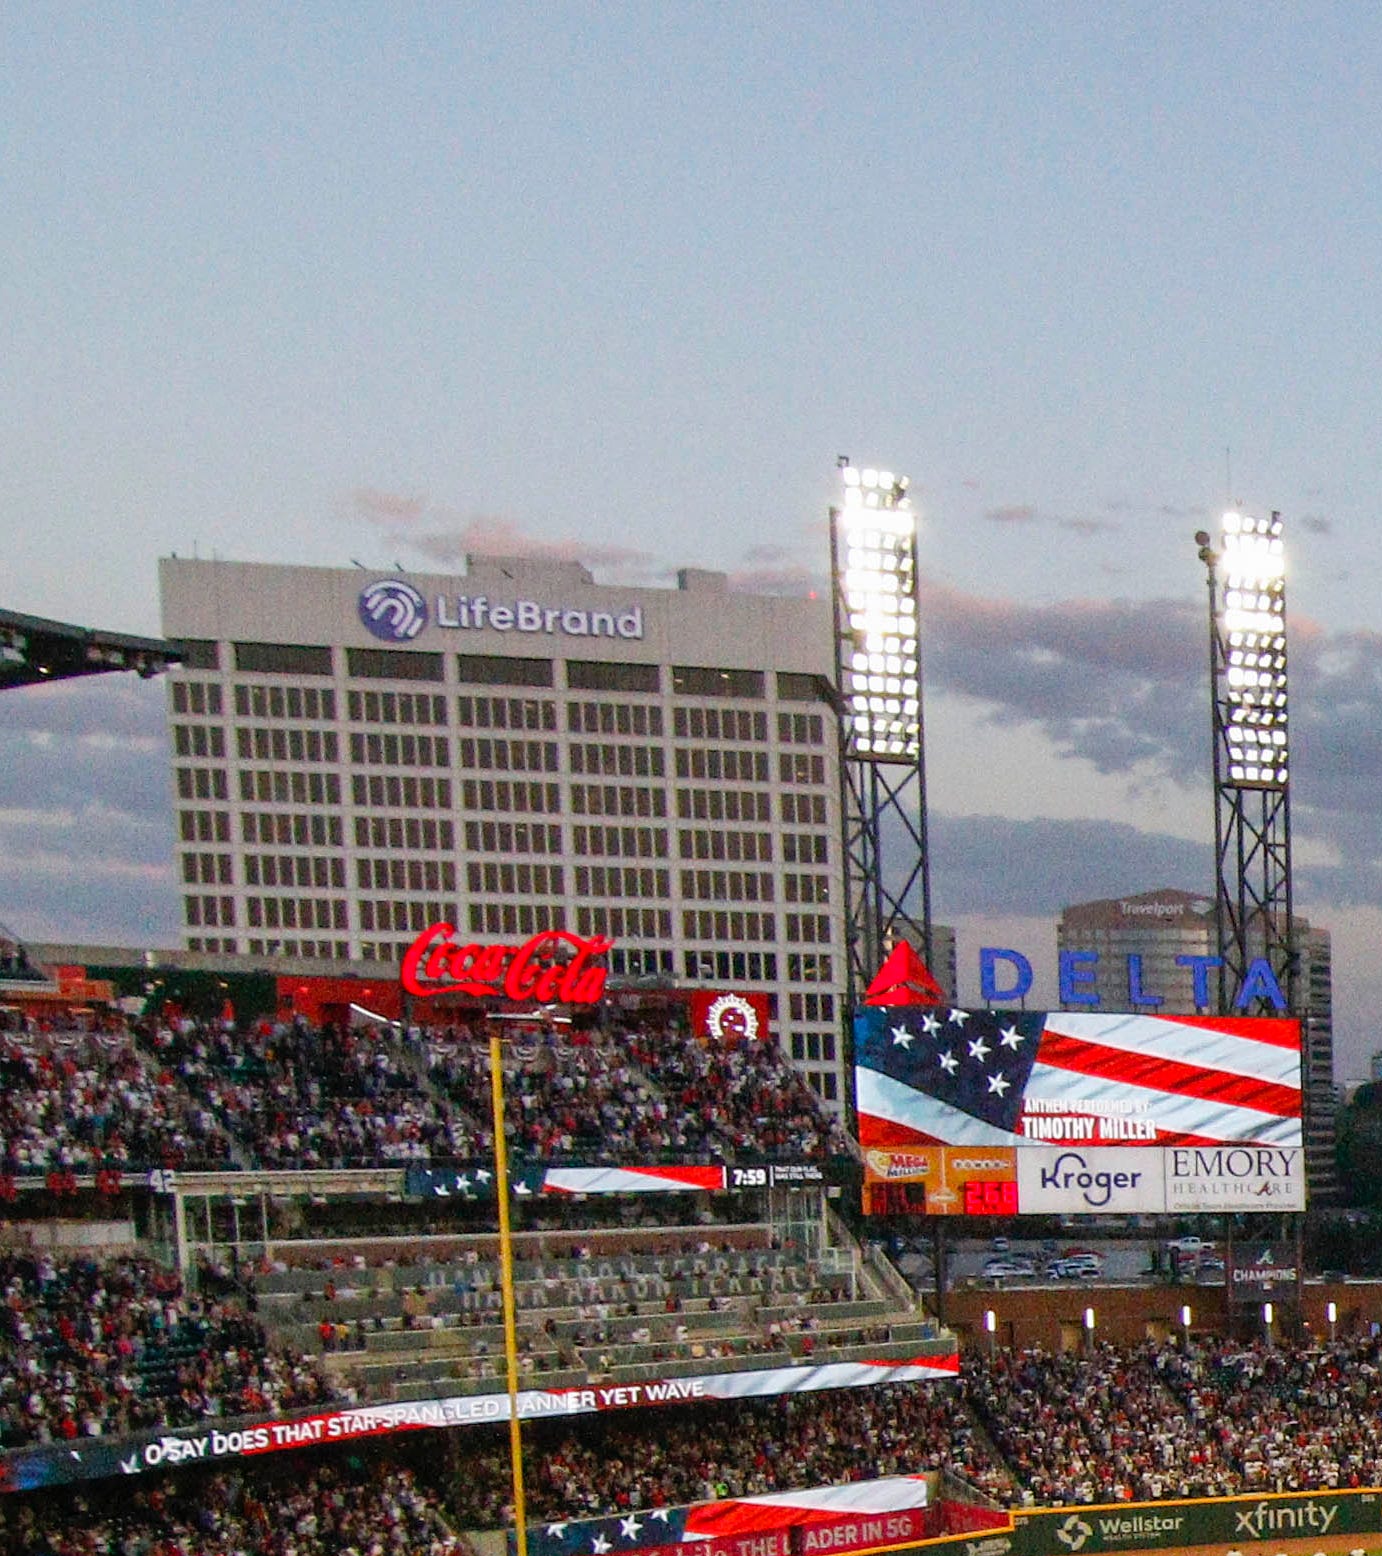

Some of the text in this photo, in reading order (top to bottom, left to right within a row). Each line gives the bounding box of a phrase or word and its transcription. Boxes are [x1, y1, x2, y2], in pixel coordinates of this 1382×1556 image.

[437, 596, 644, 640] LifeBrand
[1120, 901, 1184, 916] Travelport
[979, 947, 1288, 1009] DELTA
[1021, 1117, 1156, 1140] TIMOTHY MILLER
[1172, 1149, 1298, 1177] EMORY
[733, 1169, 766, 1186] 7:59
[1041, 1152, 1142, 1206] Kroger
[1233, 1268, 1297, 1282] CHAMPIONS
[212, 1429, 269, 1455] DOES
[271, 1420, 325, 1444] THAT
[327, 1402, 500, 1436] STAR-SPANGLED
[599, 1386, 641, 1406] YET
[645, 1380, 704, 1401] WAVE
[862, 1521, 883, 1542] IN
[886, 1516, 913, 1538] 5G
[1099, 1515, 1184, 1535] Wellstar
[1234, 1500, 1339, 1538] xfinity
